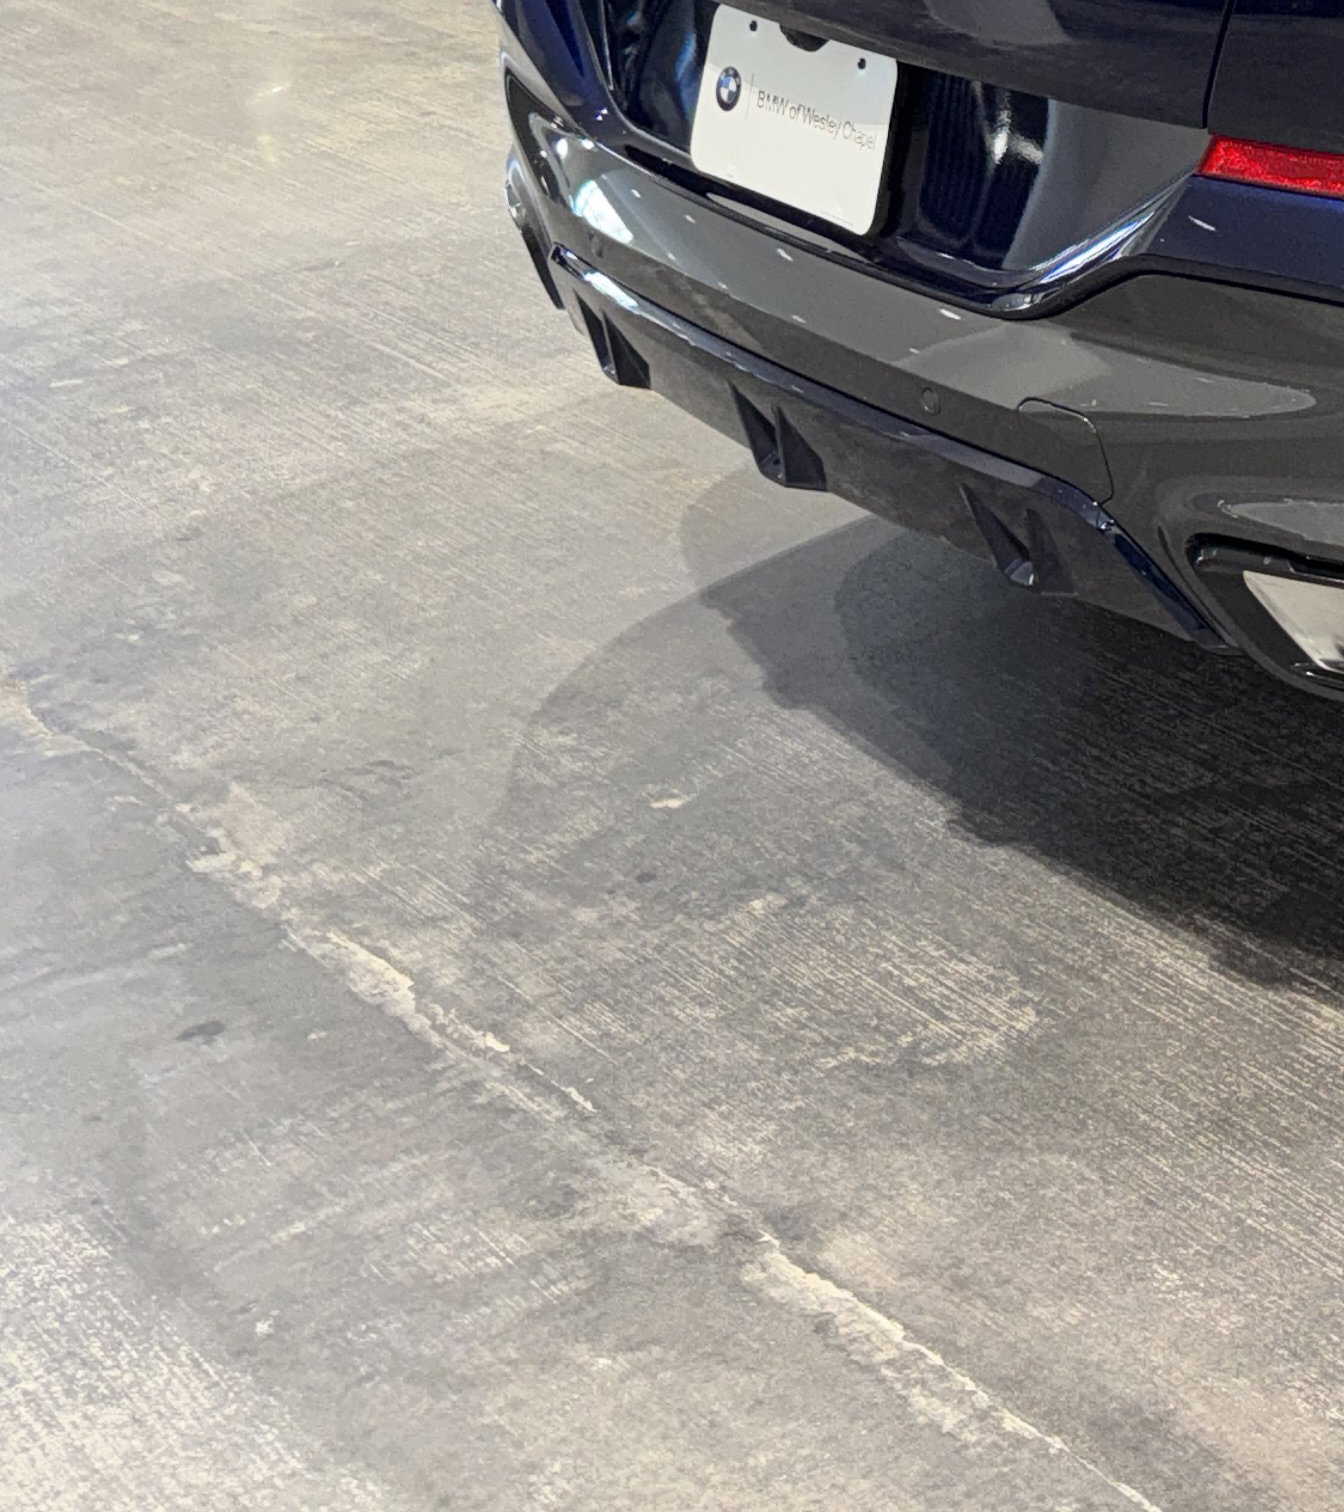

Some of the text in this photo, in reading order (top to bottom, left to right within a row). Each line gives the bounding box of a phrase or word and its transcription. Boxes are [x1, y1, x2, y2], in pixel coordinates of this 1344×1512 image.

[757, 90, 877, 151] BMW of Wesley Chapel
